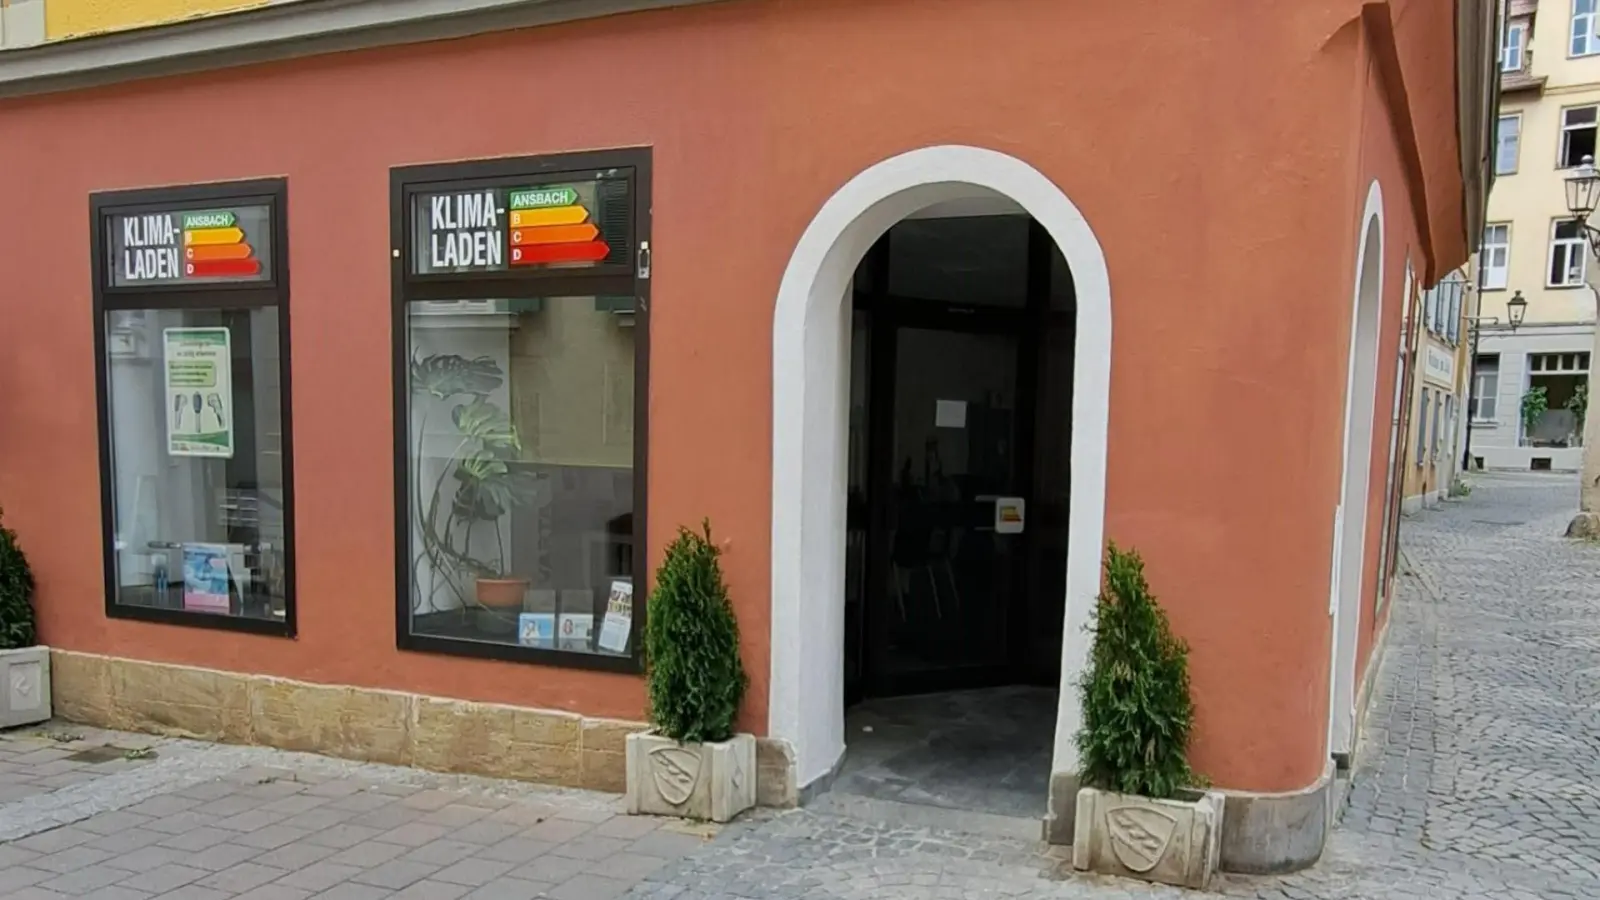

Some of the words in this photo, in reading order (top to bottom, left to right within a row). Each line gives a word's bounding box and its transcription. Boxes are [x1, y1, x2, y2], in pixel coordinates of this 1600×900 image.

[513, 191, 568, 207] ANSBACH
[431, 192, 505, 230] KLIMA-
[186, 213, 229, 226] ANSBACH
[513, 213, 521, 224] B
[123, 214, 180, 246] KLIMA-
[513, 231, 522, 242] C
[186, 248, 194, 259] C
[432, 231, 501, 267] LADEN
[512, 249, 522, 260] D
[125, 248, 179, 280] LADEN
[186, 264, 194, 274] D
